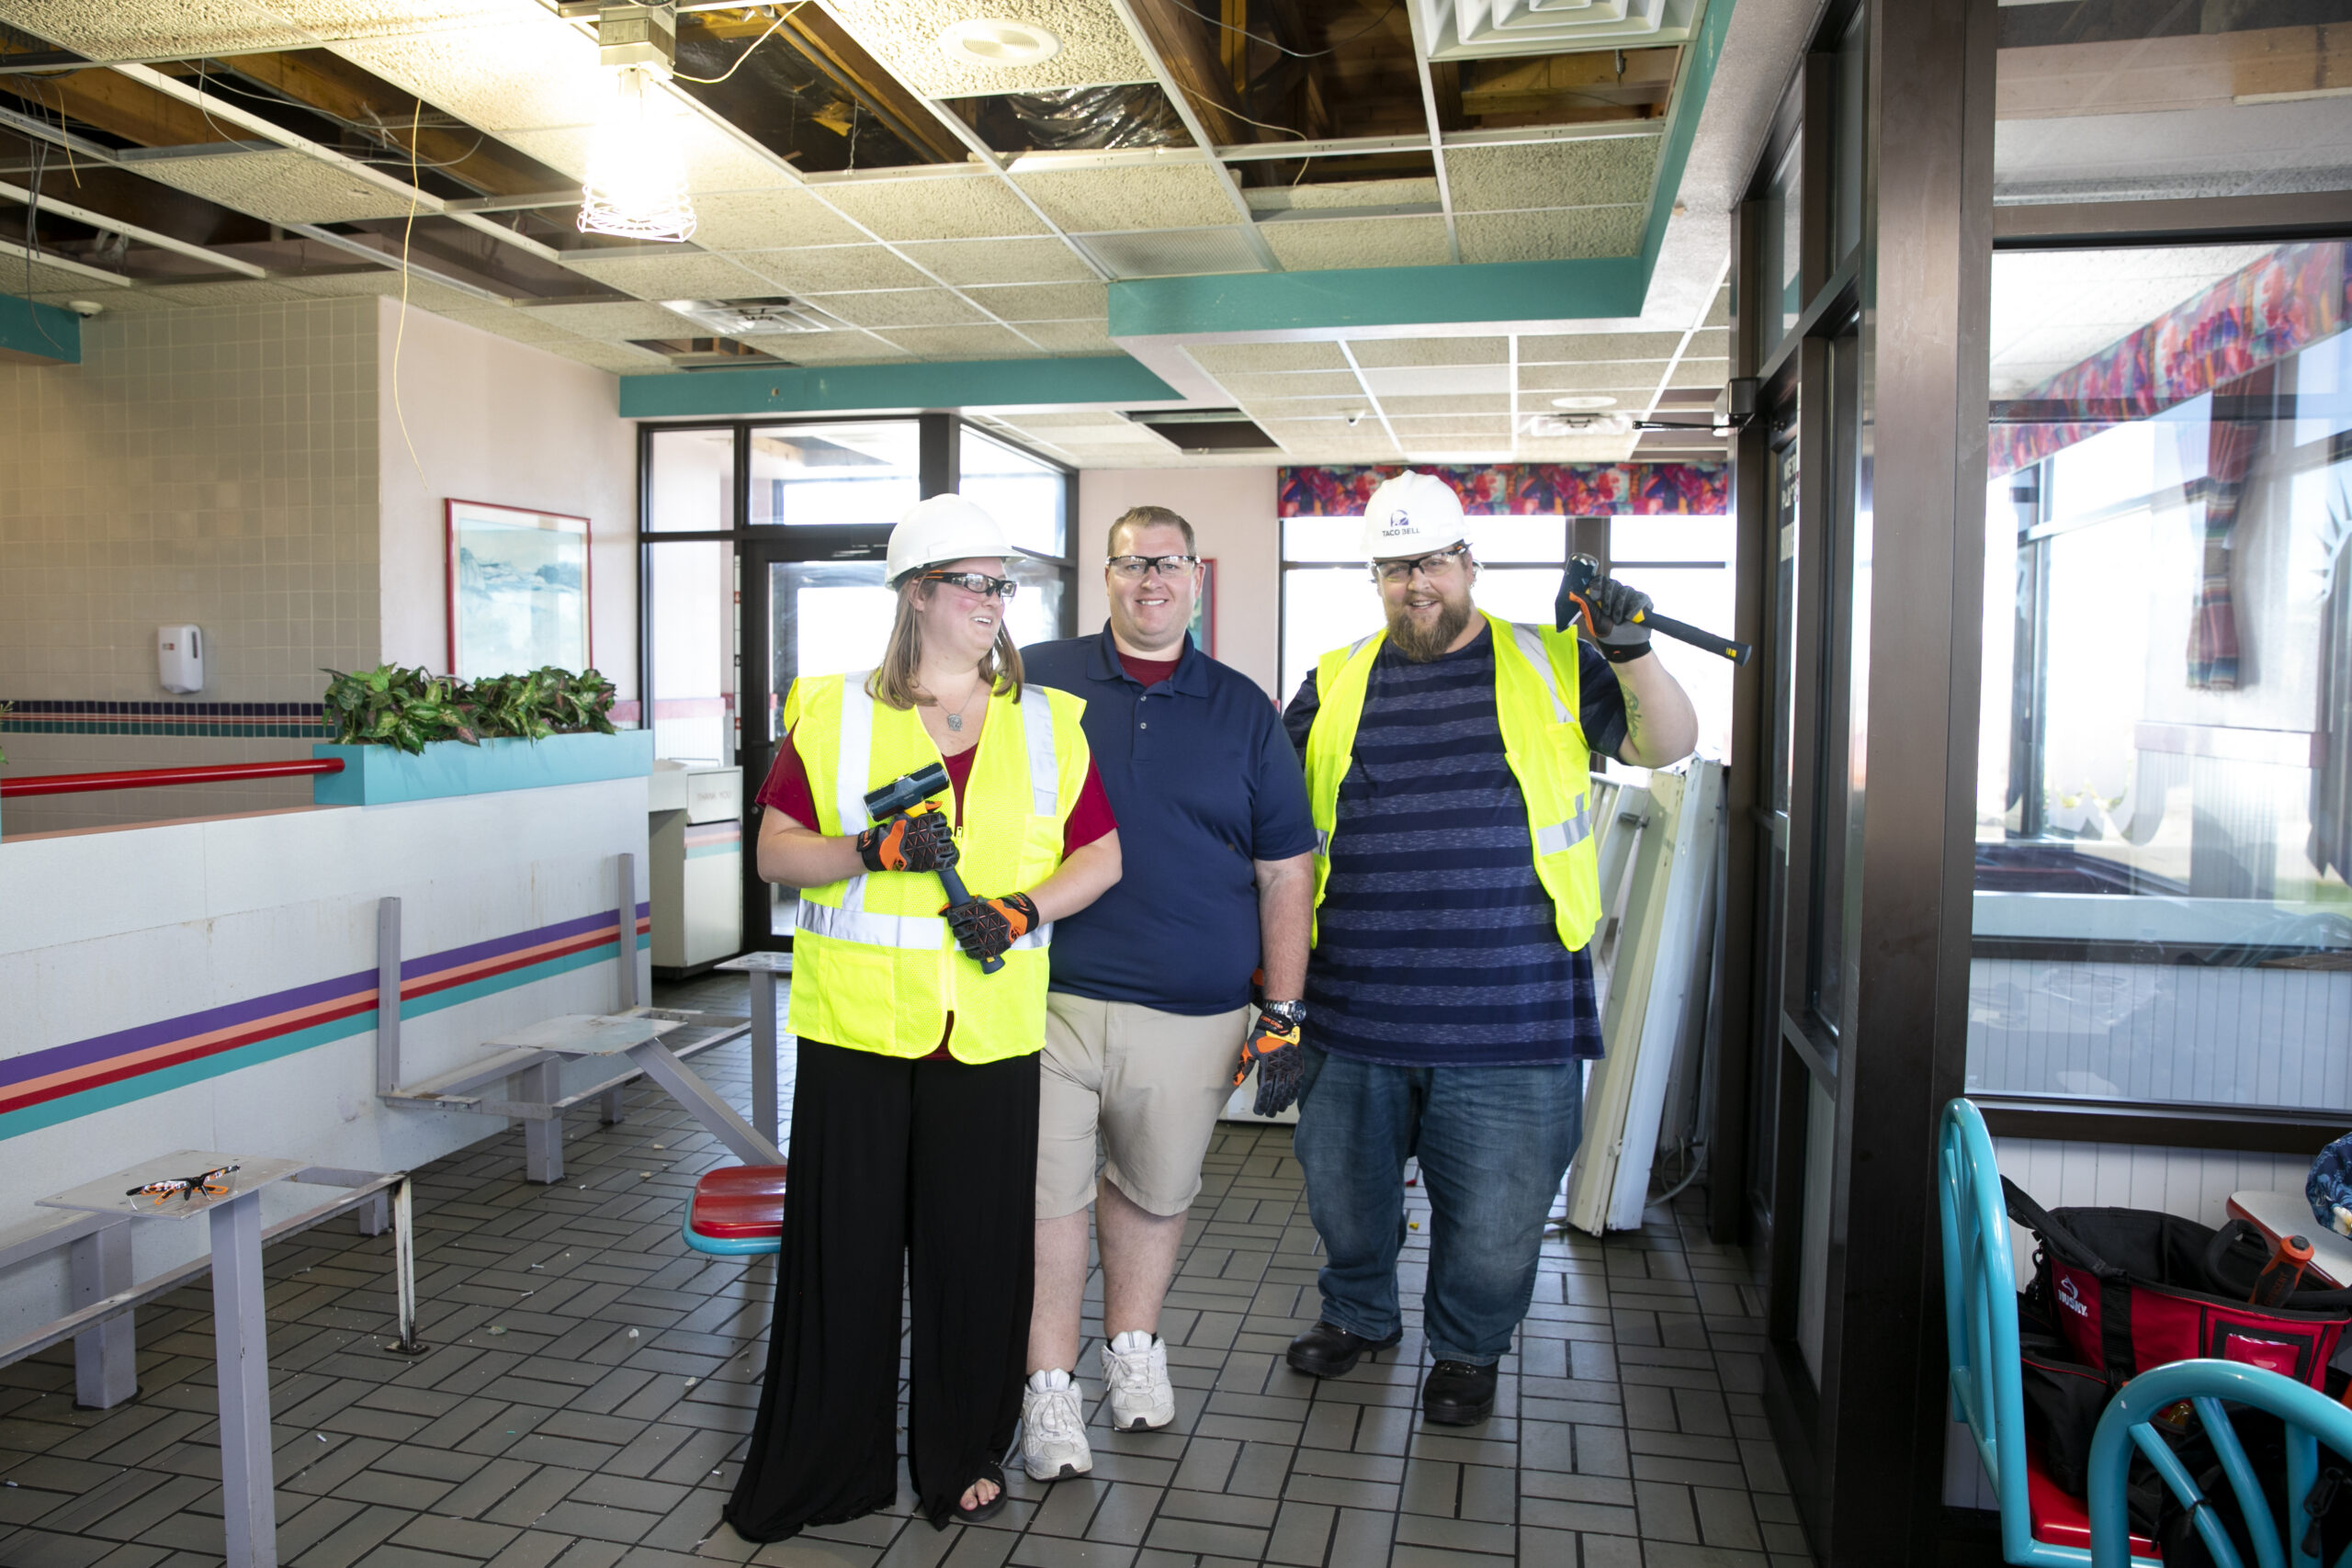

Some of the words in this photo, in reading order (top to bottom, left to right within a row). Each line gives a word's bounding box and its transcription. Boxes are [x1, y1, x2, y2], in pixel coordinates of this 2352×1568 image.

[1382, 529, 1401, 537] TACO
[1402, 527, 1421, 536] BELL
[696, 792, 718, 802] THANK
[718, 790, 732, 800] YOU
[2057, 1289, 2087, 1316] HUSKY
